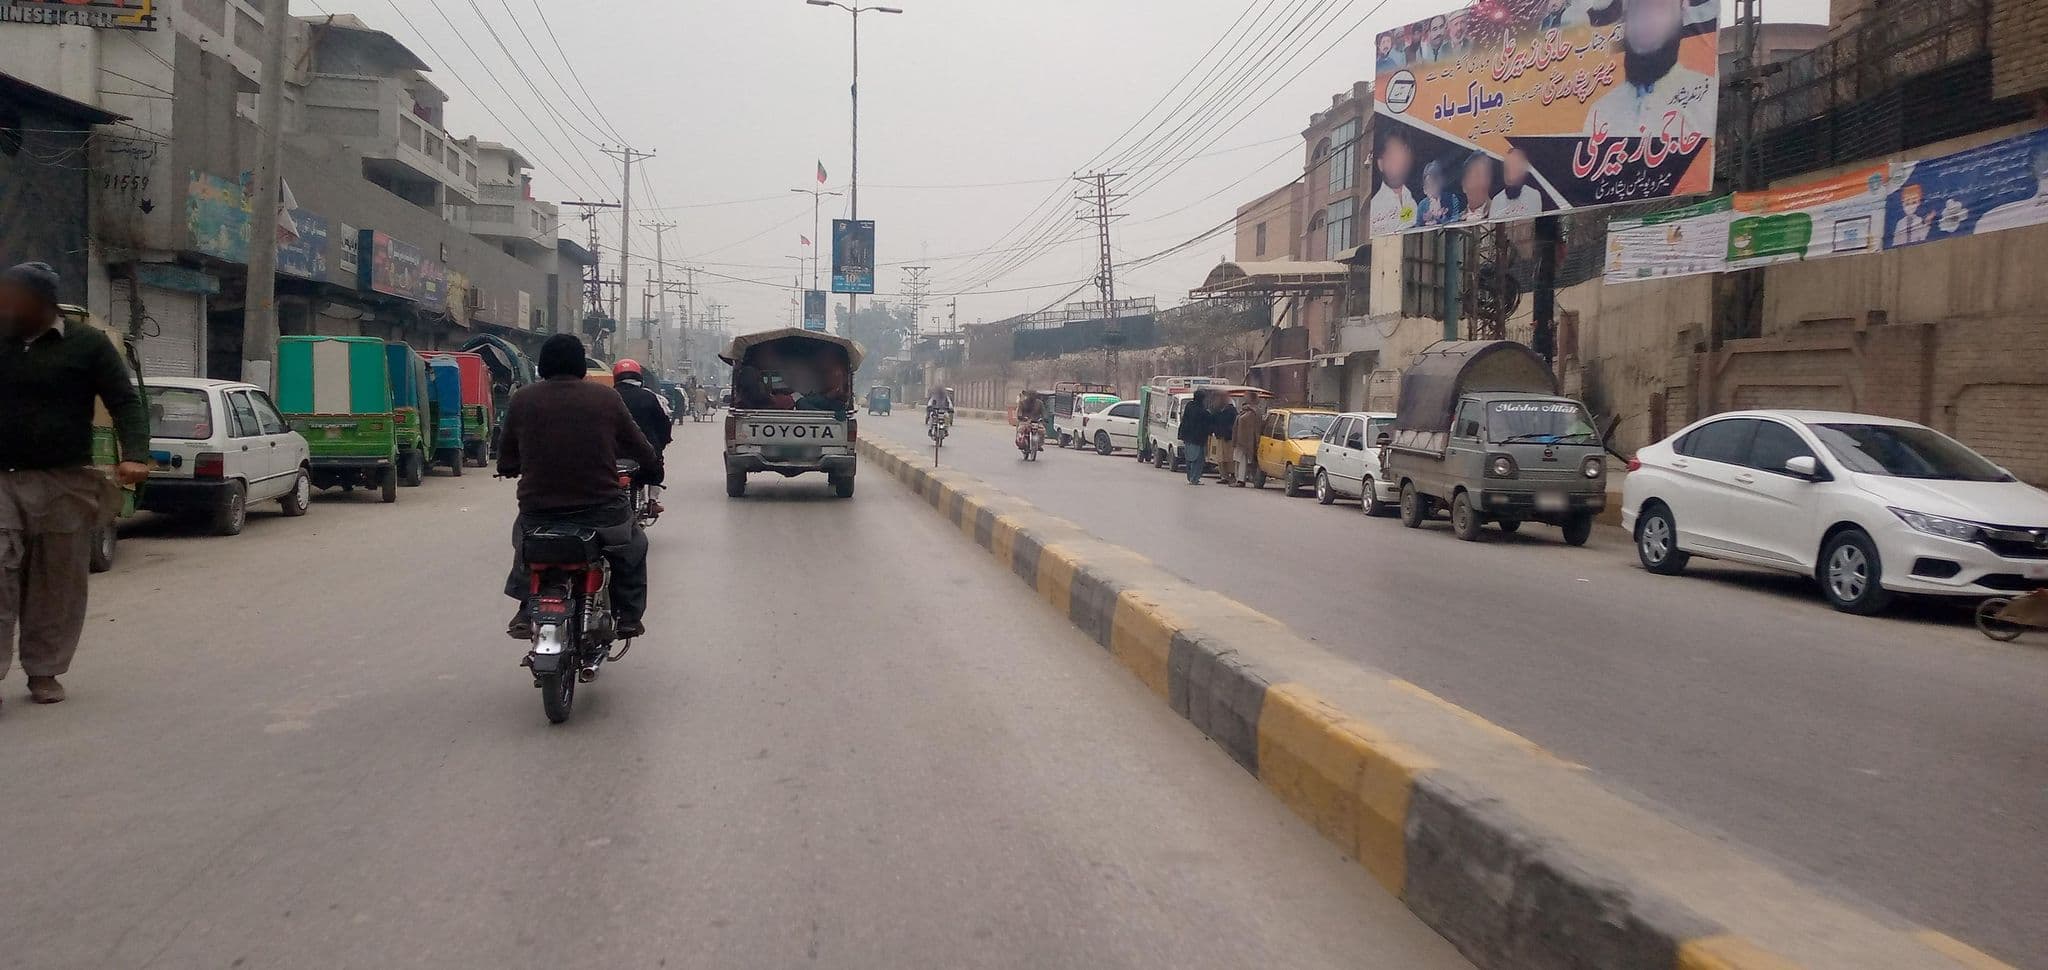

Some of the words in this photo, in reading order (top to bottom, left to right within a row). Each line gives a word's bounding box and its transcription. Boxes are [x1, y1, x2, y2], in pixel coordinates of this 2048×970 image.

[1492, 27, 1517, 80] علی
[1503, 38, 1540, 82] زبیر
[1537, 27, 1573, 70] حاجی
[1574, 32, 1606, 58] جناب
[1434, 93, 1456, 120] باد
[1457, 80, 1504, 117] مبارک
[1573, 110, 1609, 178] علی
[1590, 125, 1649, 181] زبیر
[1643, 109, 1703, 168] حاجی
[749, 424, 834, 438] TOYOTA
